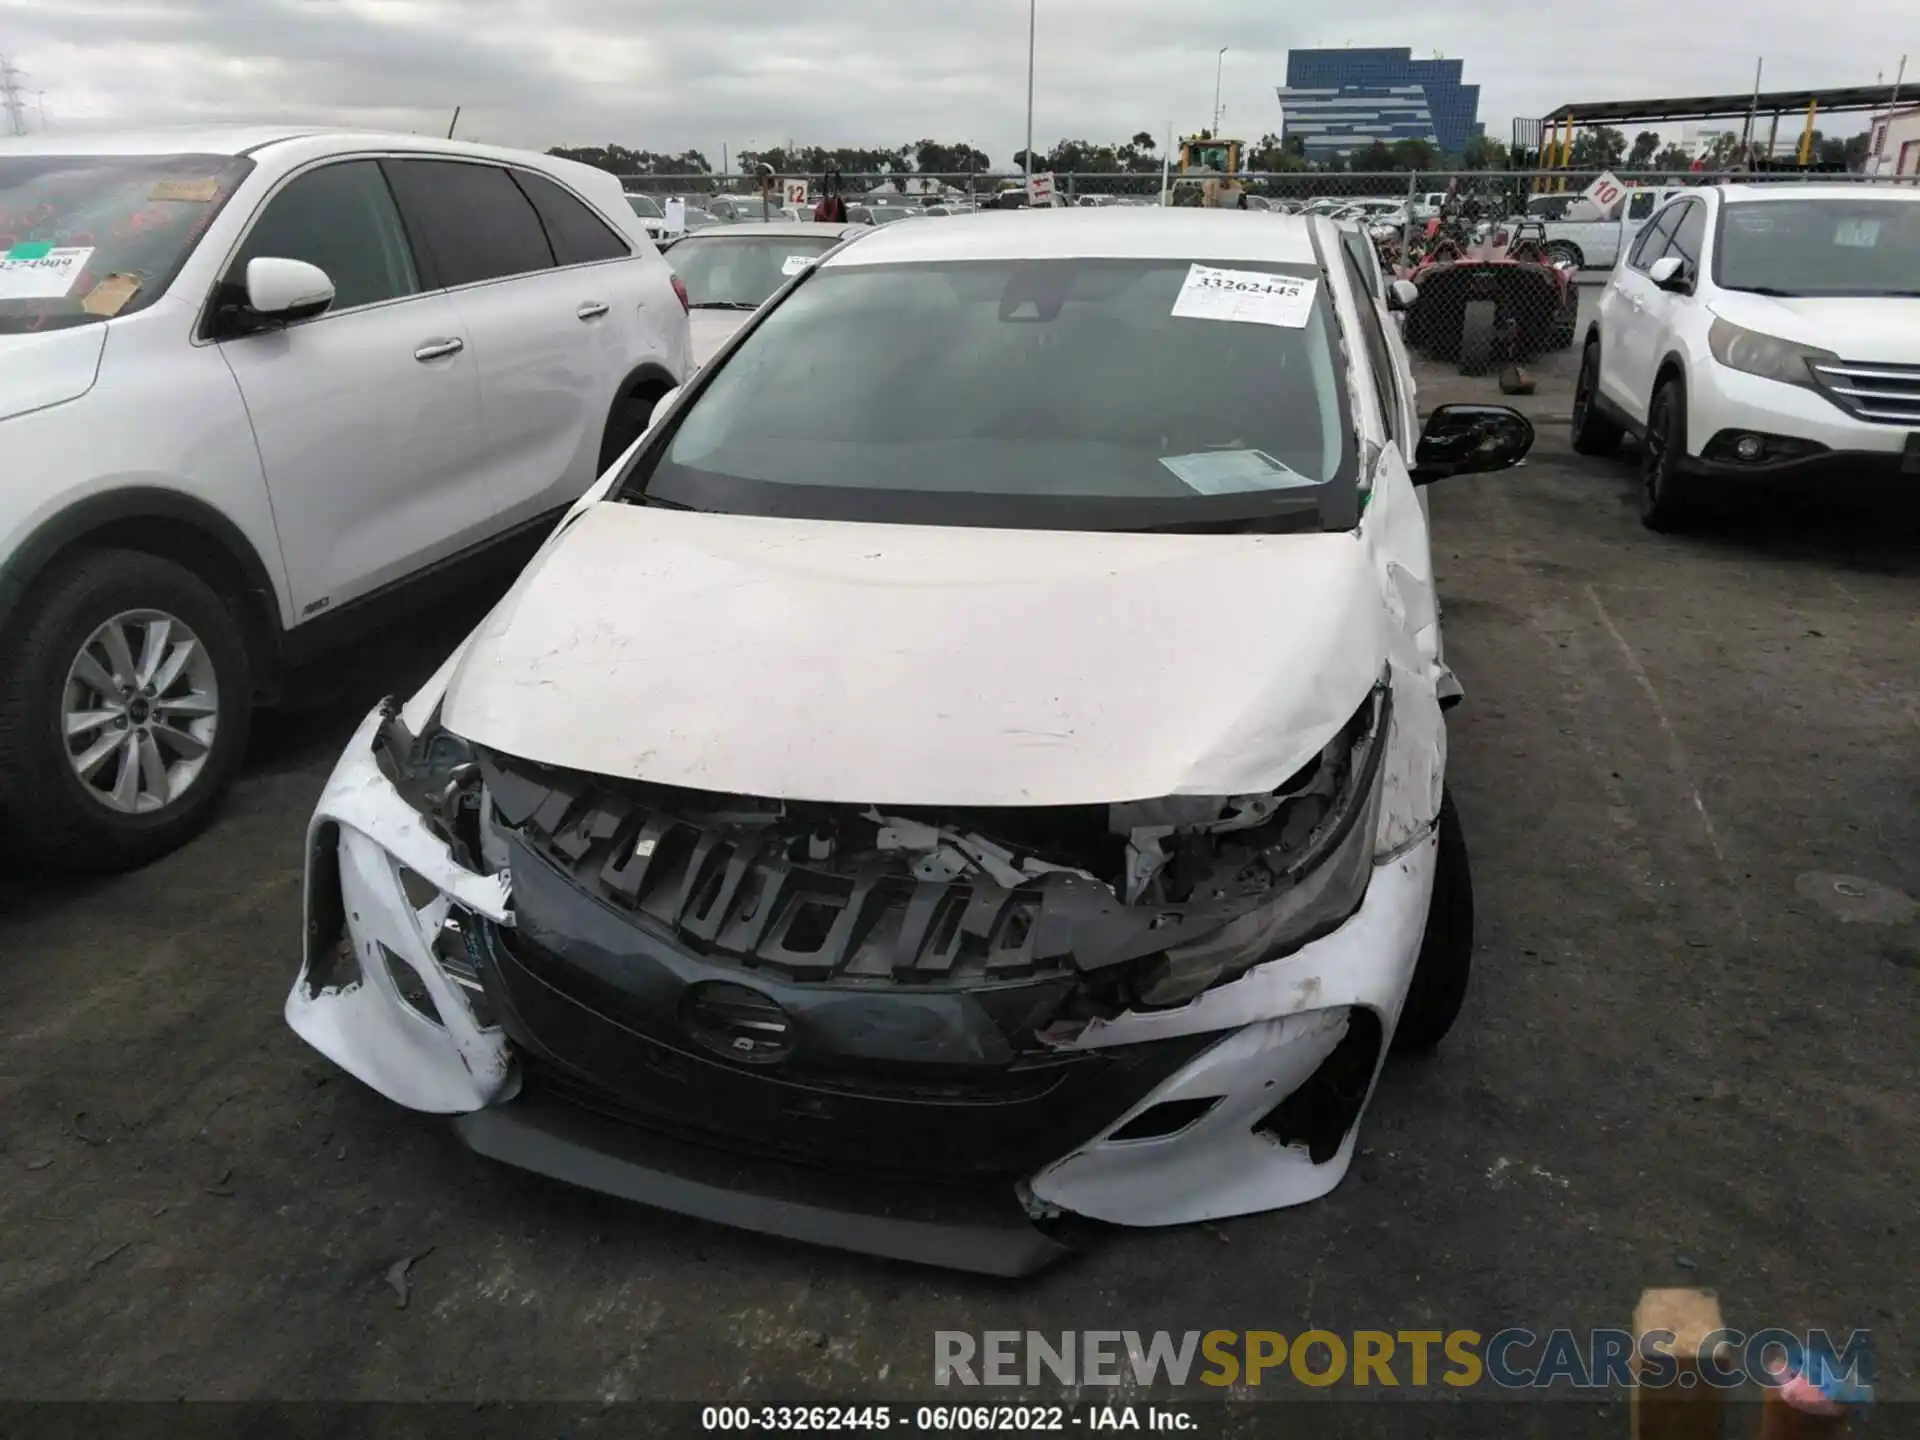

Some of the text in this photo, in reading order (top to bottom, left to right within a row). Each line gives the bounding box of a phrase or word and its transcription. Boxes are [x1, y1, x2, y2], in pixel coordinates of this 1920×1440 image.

[787, 185, 805, 203] 12
[1594, 181, 1618, 204] 10
[1197, 277, 1300, 298] 33262445
